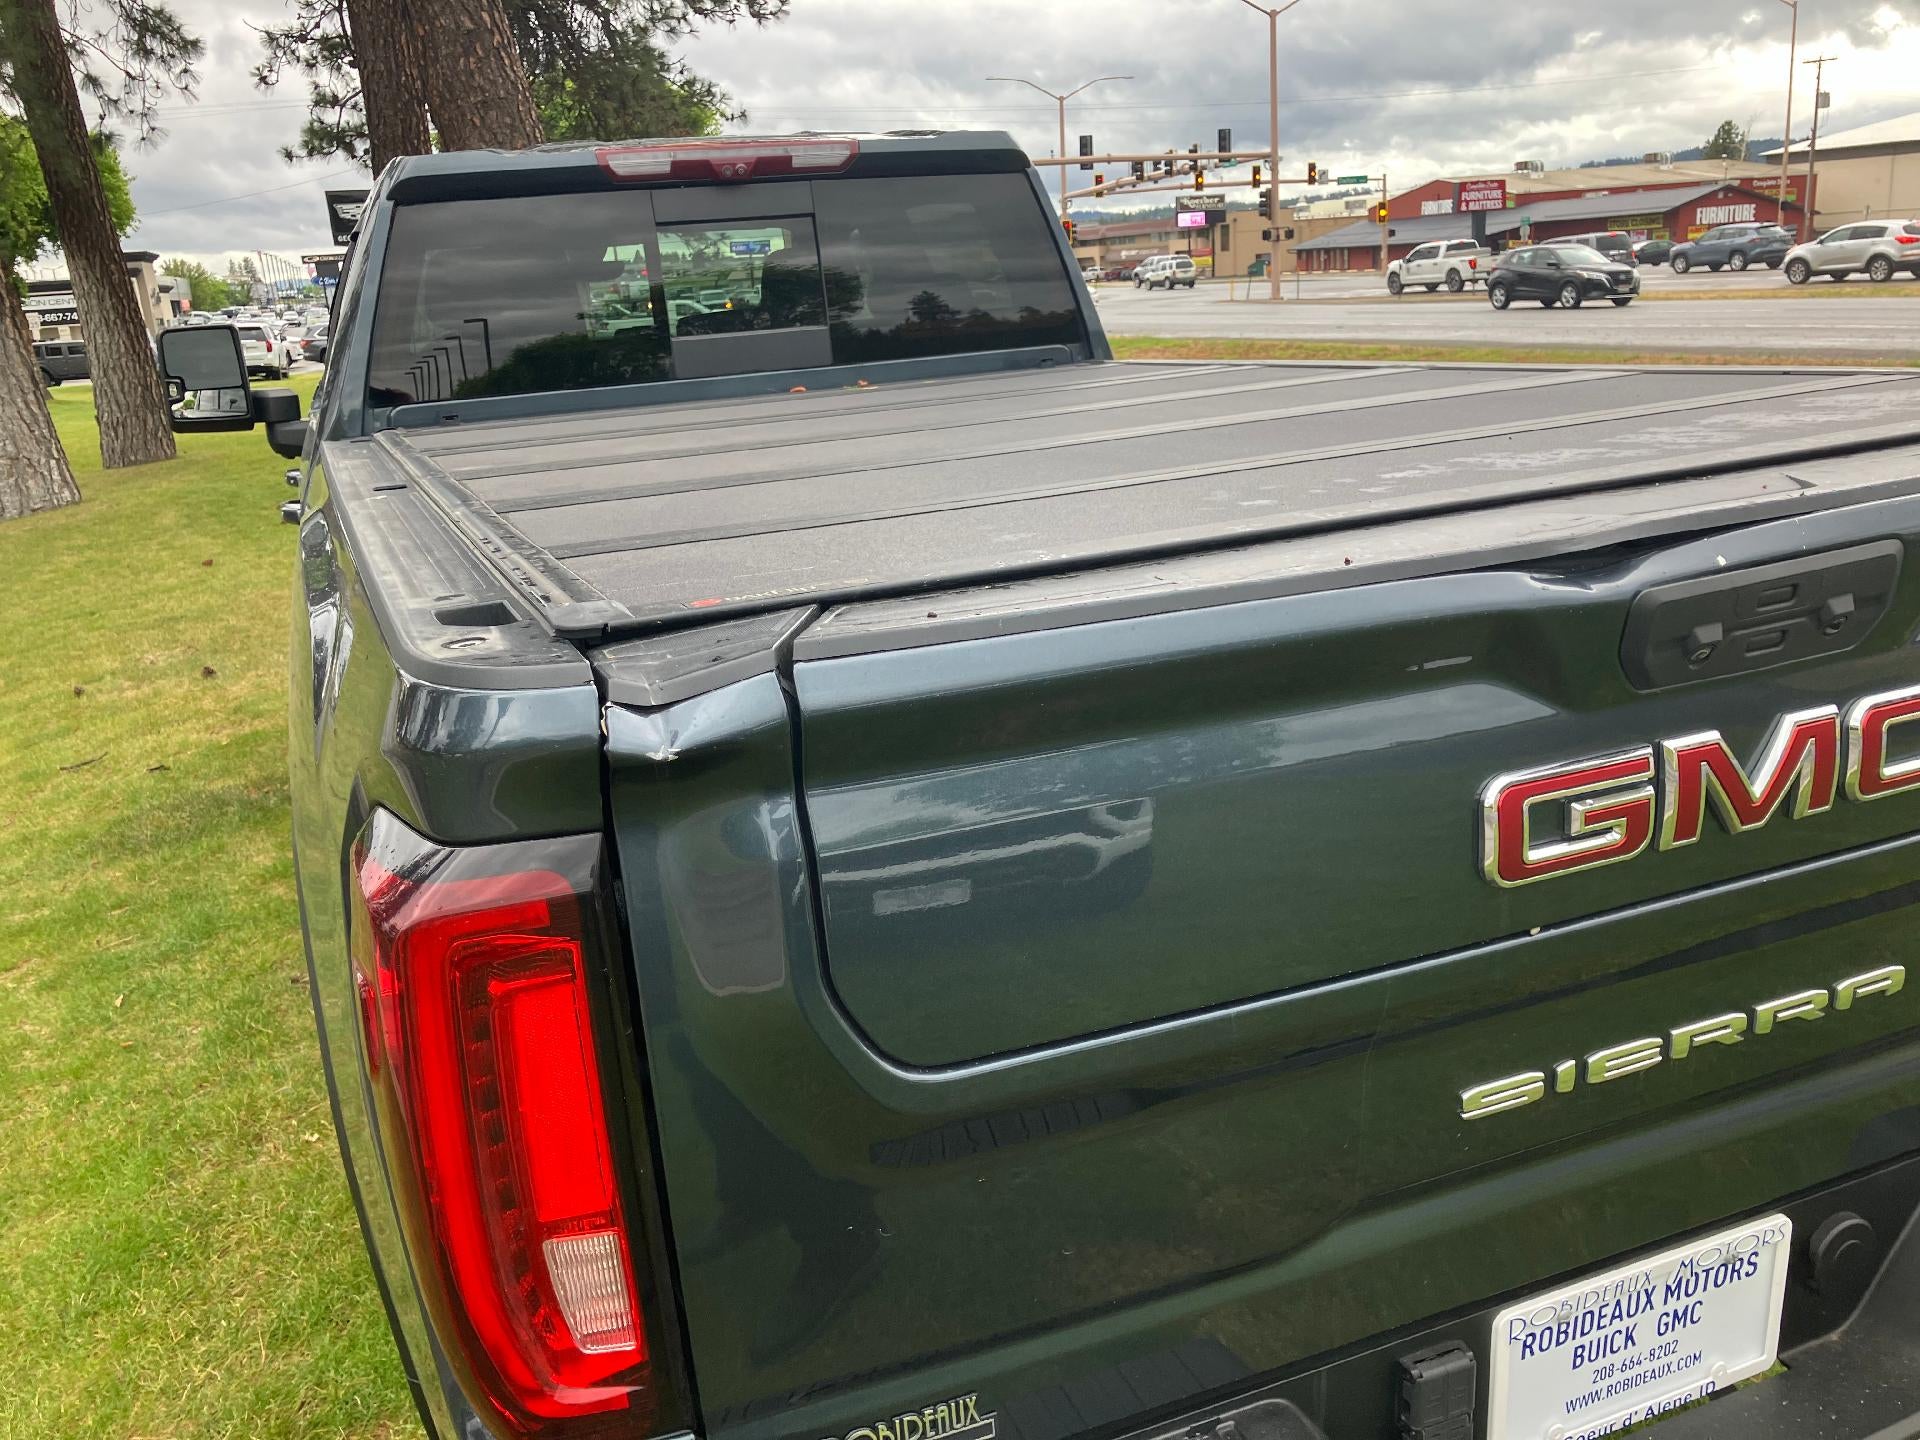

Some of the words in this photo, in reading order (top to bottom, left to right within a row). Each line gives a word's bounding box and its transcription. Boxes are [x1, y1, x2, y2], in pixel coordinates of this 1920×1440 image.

[1460, 202, 1467, 211] &
[1468, 200, 1503, 211] MATTRESS
[1461, 190, 1503, 200] FURNITURE
[1752, 179, 1776, 188] Complete
[1421, 199, 1453, 215] FURNITURE
[1696, 204, 1756, 225] FURNITURE
[1459, 965, 1906, 1120] SIERRA
[1508, 1269, 1653, 1345] ROBIDEAUX
[1666, 1222, 1786, 1287] MOTORS
[1520, 1286, 1656, 1360] ROBIDEAUX
[1663, 1251, 1760, 1305] MOTORS
[1571, 1324, 1637, 1370] BUICK
[1656, 1301, 1703, 1337] GMC
[1564, 1351, 1702, 1415] WWW.ROBIDEAUX.COM
[1592, 1339, 1679, 1384] 208-664-8202
[820, 1393, 981, 1440] OBIDEAUX
[1644, 1393, 1693, 1421] Alene
